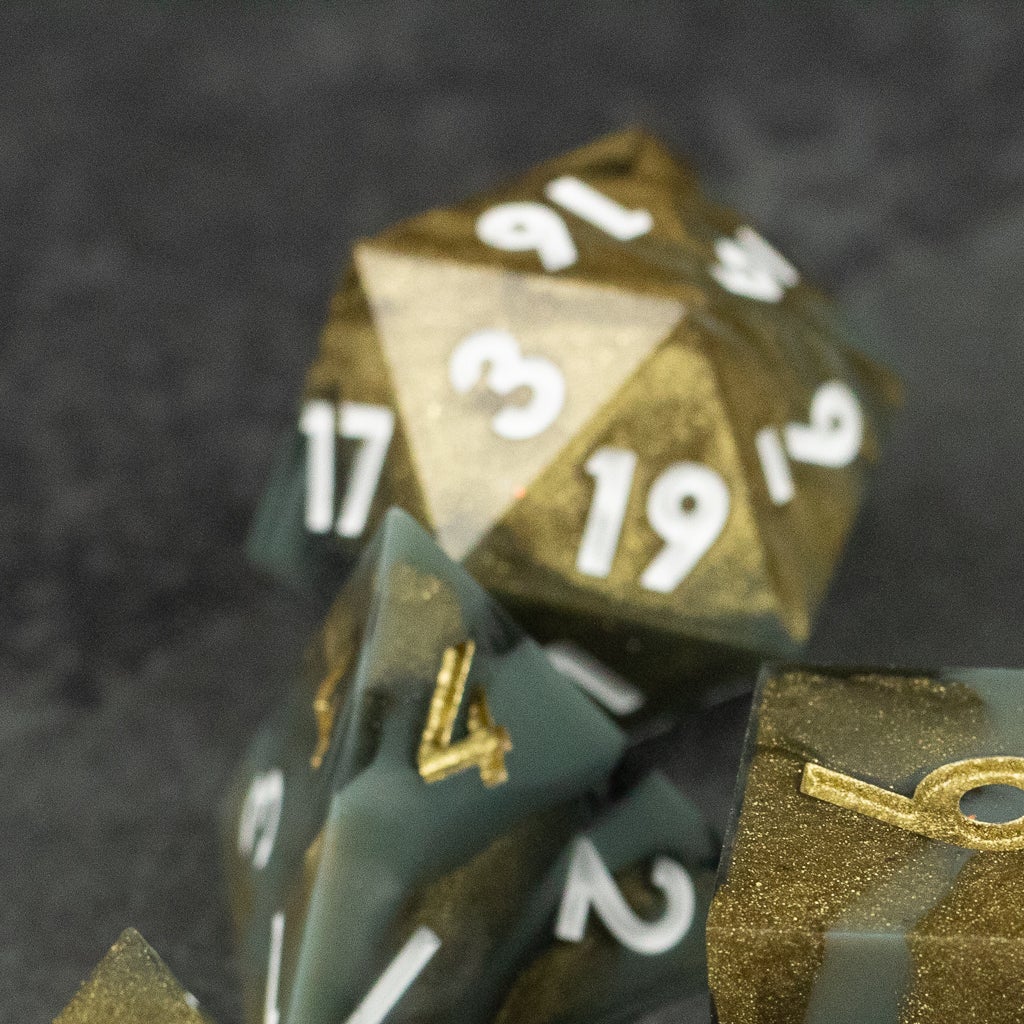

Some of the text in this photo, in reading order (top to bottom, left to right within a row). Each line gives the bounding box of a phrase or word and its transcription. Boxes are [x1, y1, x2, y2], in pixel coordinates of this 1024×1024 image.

[475, 176, 654, 272] 16
[450, 329, 566, 440] 3
[299, 400, 395, 538] 17
[577, 446, 730, 594] 19
[418, 640, 512, 787] 4
[554, 834, 698, 957] 2
